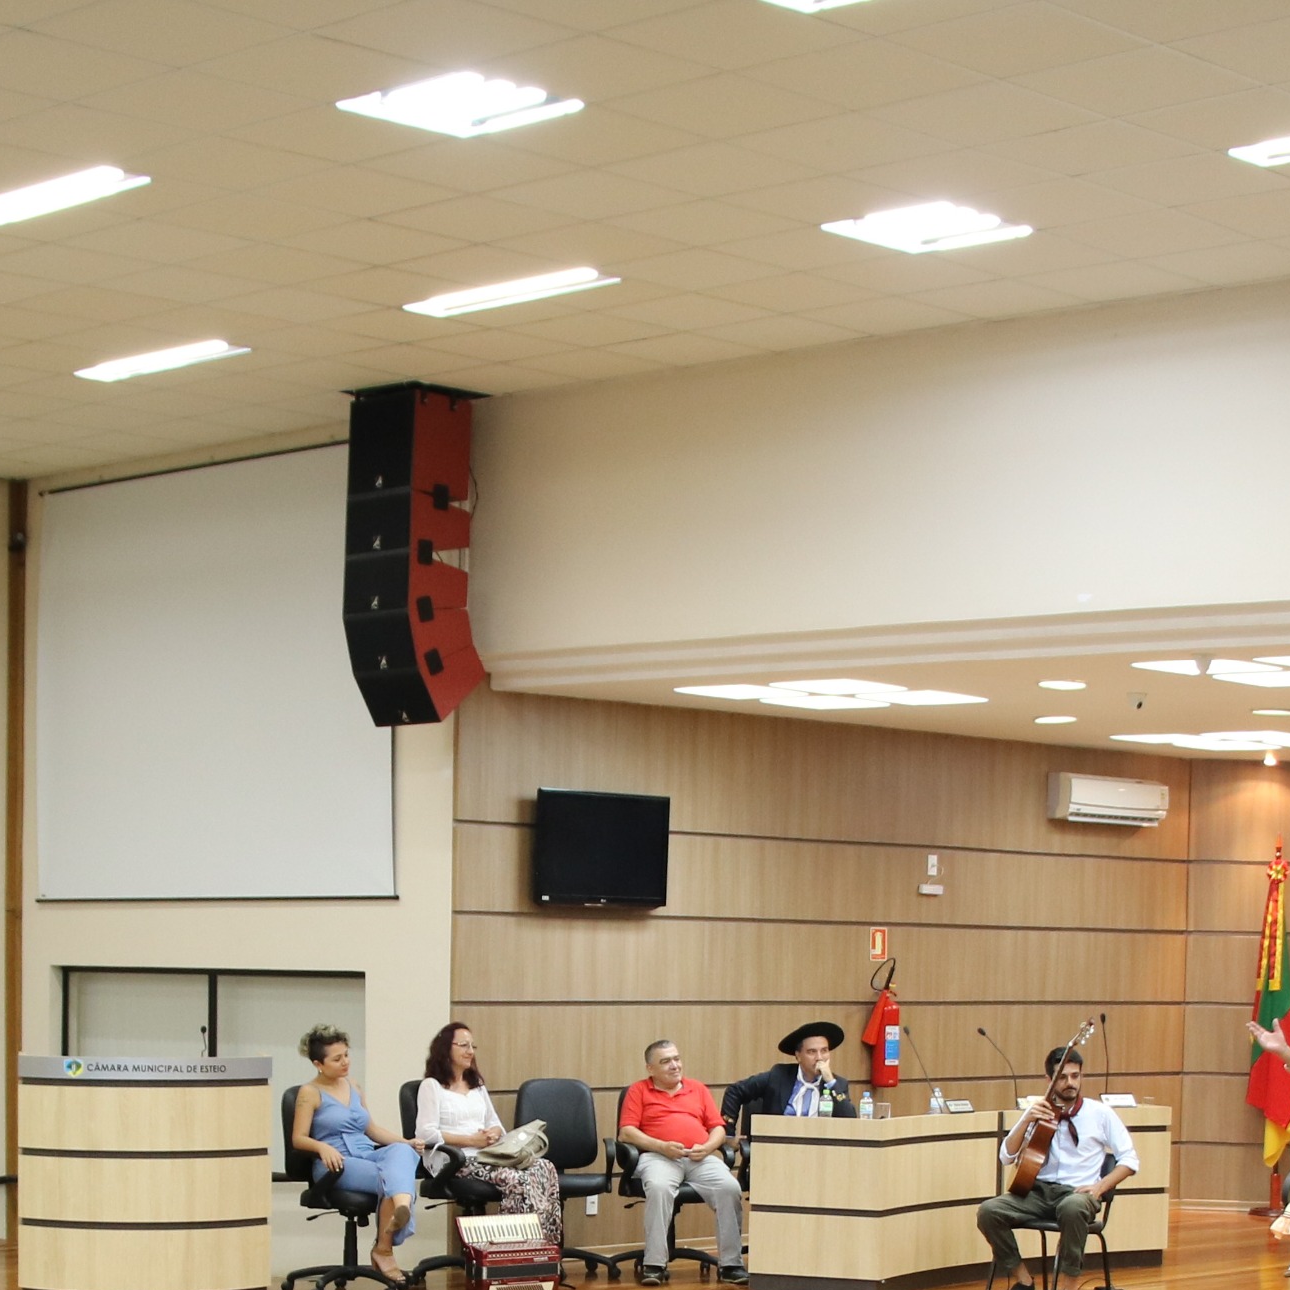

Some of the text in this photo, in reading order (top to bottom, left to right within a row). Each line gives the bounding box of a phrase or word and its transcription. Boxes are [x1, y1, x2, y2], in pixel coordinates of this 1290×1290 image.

[86, 1062, 227, 1074] CÂMARA MUNICIPAL DE ESTEIO
